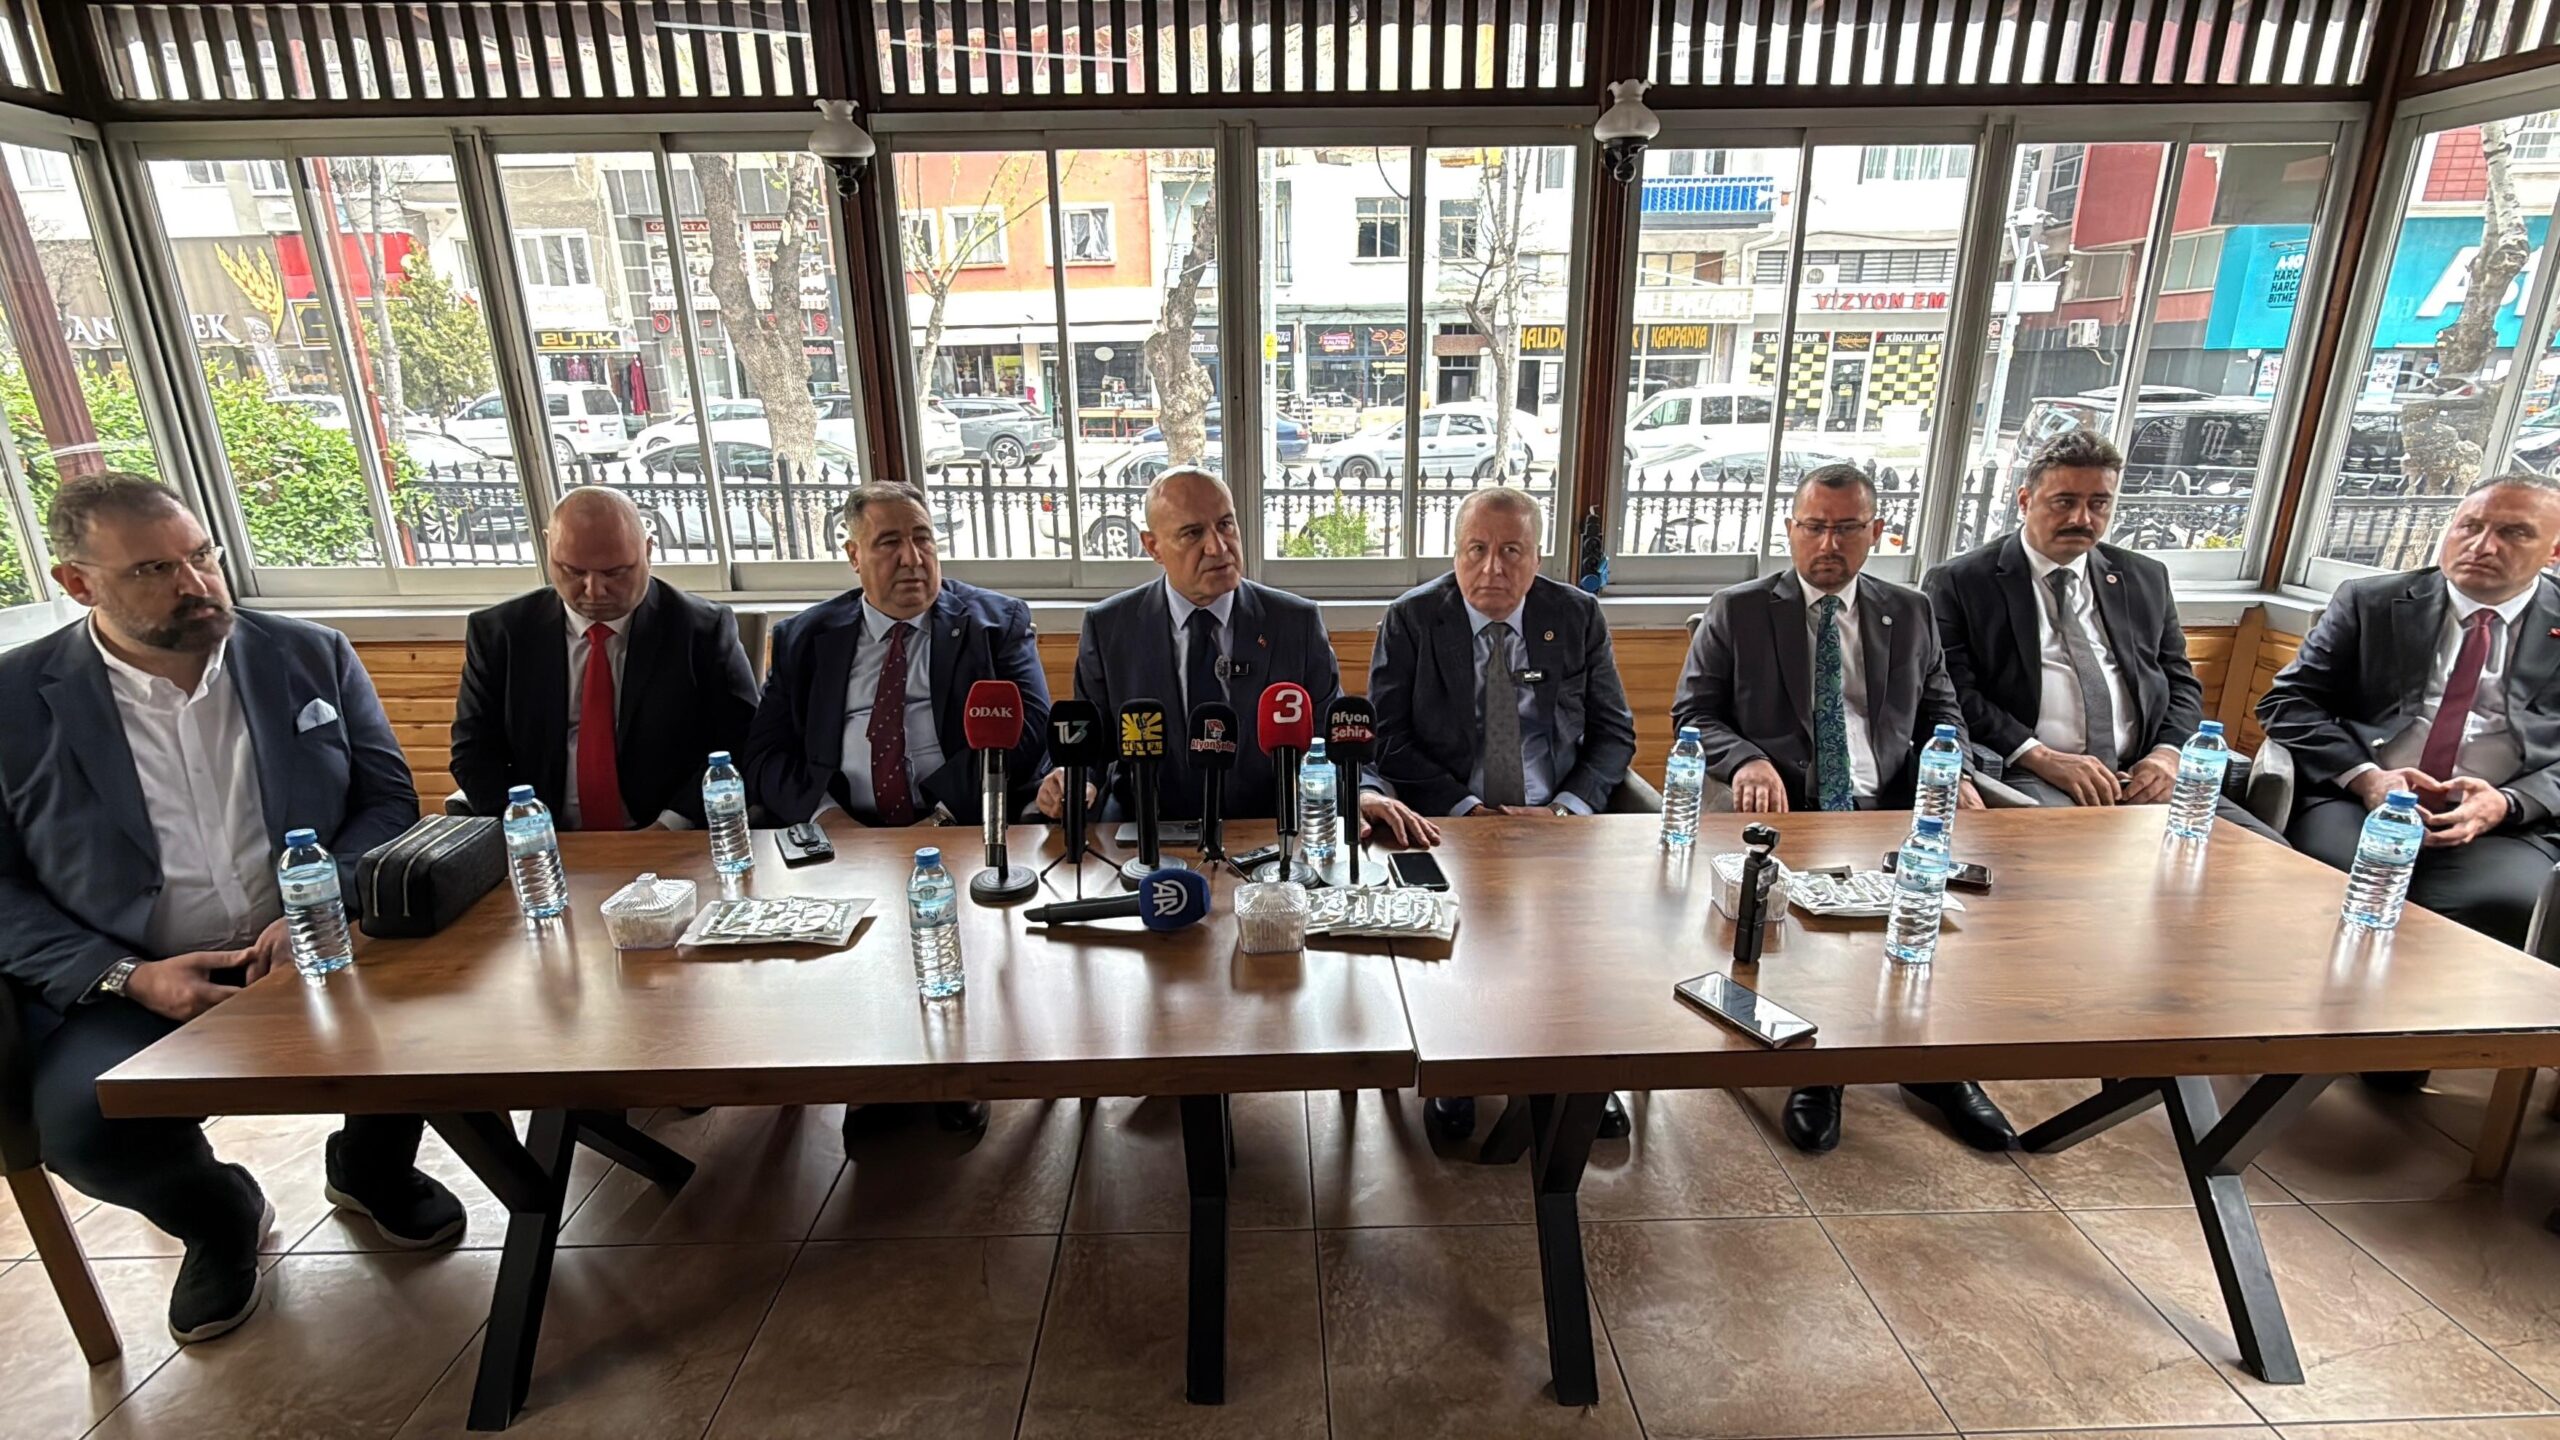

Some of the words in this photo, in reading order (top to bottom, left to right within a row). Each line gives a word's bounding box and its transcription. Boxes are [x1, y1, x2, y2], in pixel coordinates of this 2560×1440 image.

[1816, 287, 1904, 311] VİZYON
[1912, 292, 1947, 310] EM
[1651, 325, 1708, 350] KAMPANYA
[969, 706, 1013, 718] ODAK
[1273, 689, 1303, 724] 3
[1332, 711, 1370, 725] Afyon
[1053, 720, 1090, 745] TV3
[1331, 725, 1366, 742] Şehir
